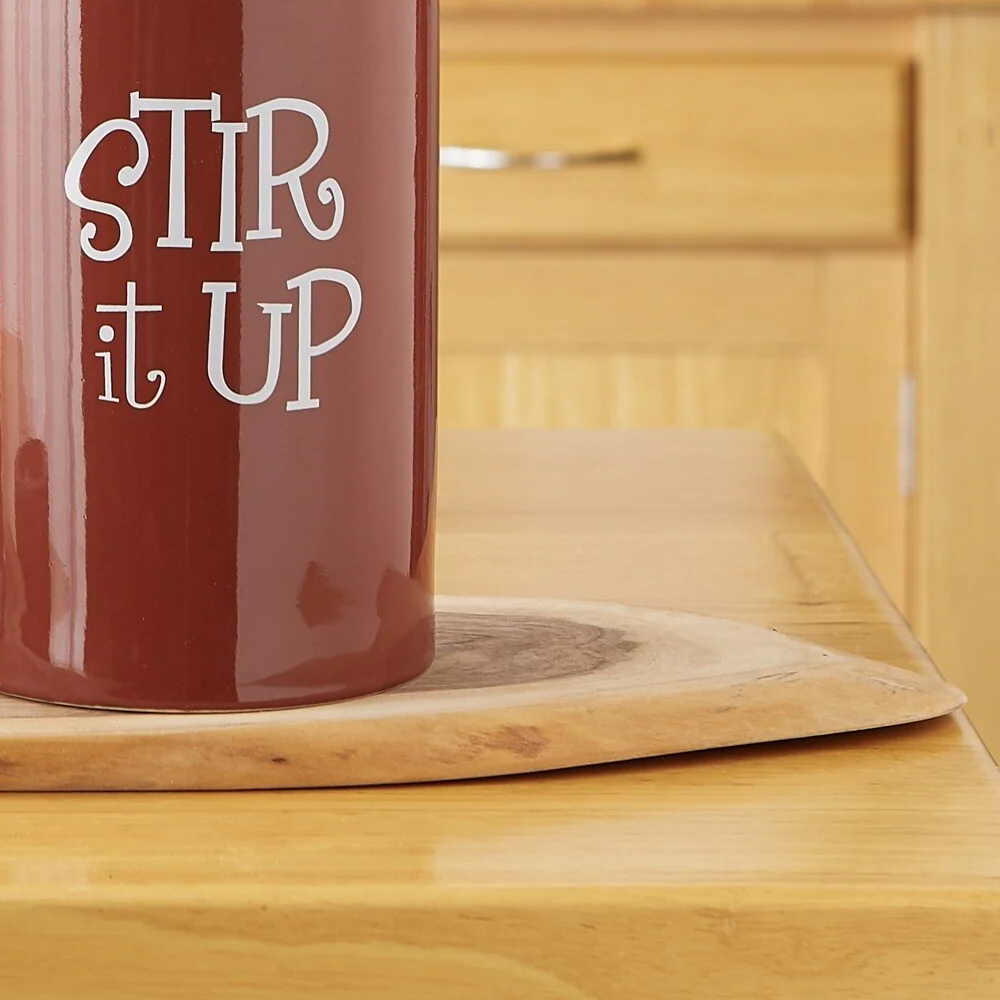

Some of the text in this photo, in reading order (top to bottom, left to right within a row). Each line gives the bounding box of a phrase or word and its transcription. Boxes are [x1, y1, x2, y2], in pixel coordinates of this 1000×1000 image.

[63, 91, 345, 262] STIR
[95, 268, 362, 411] it UP
